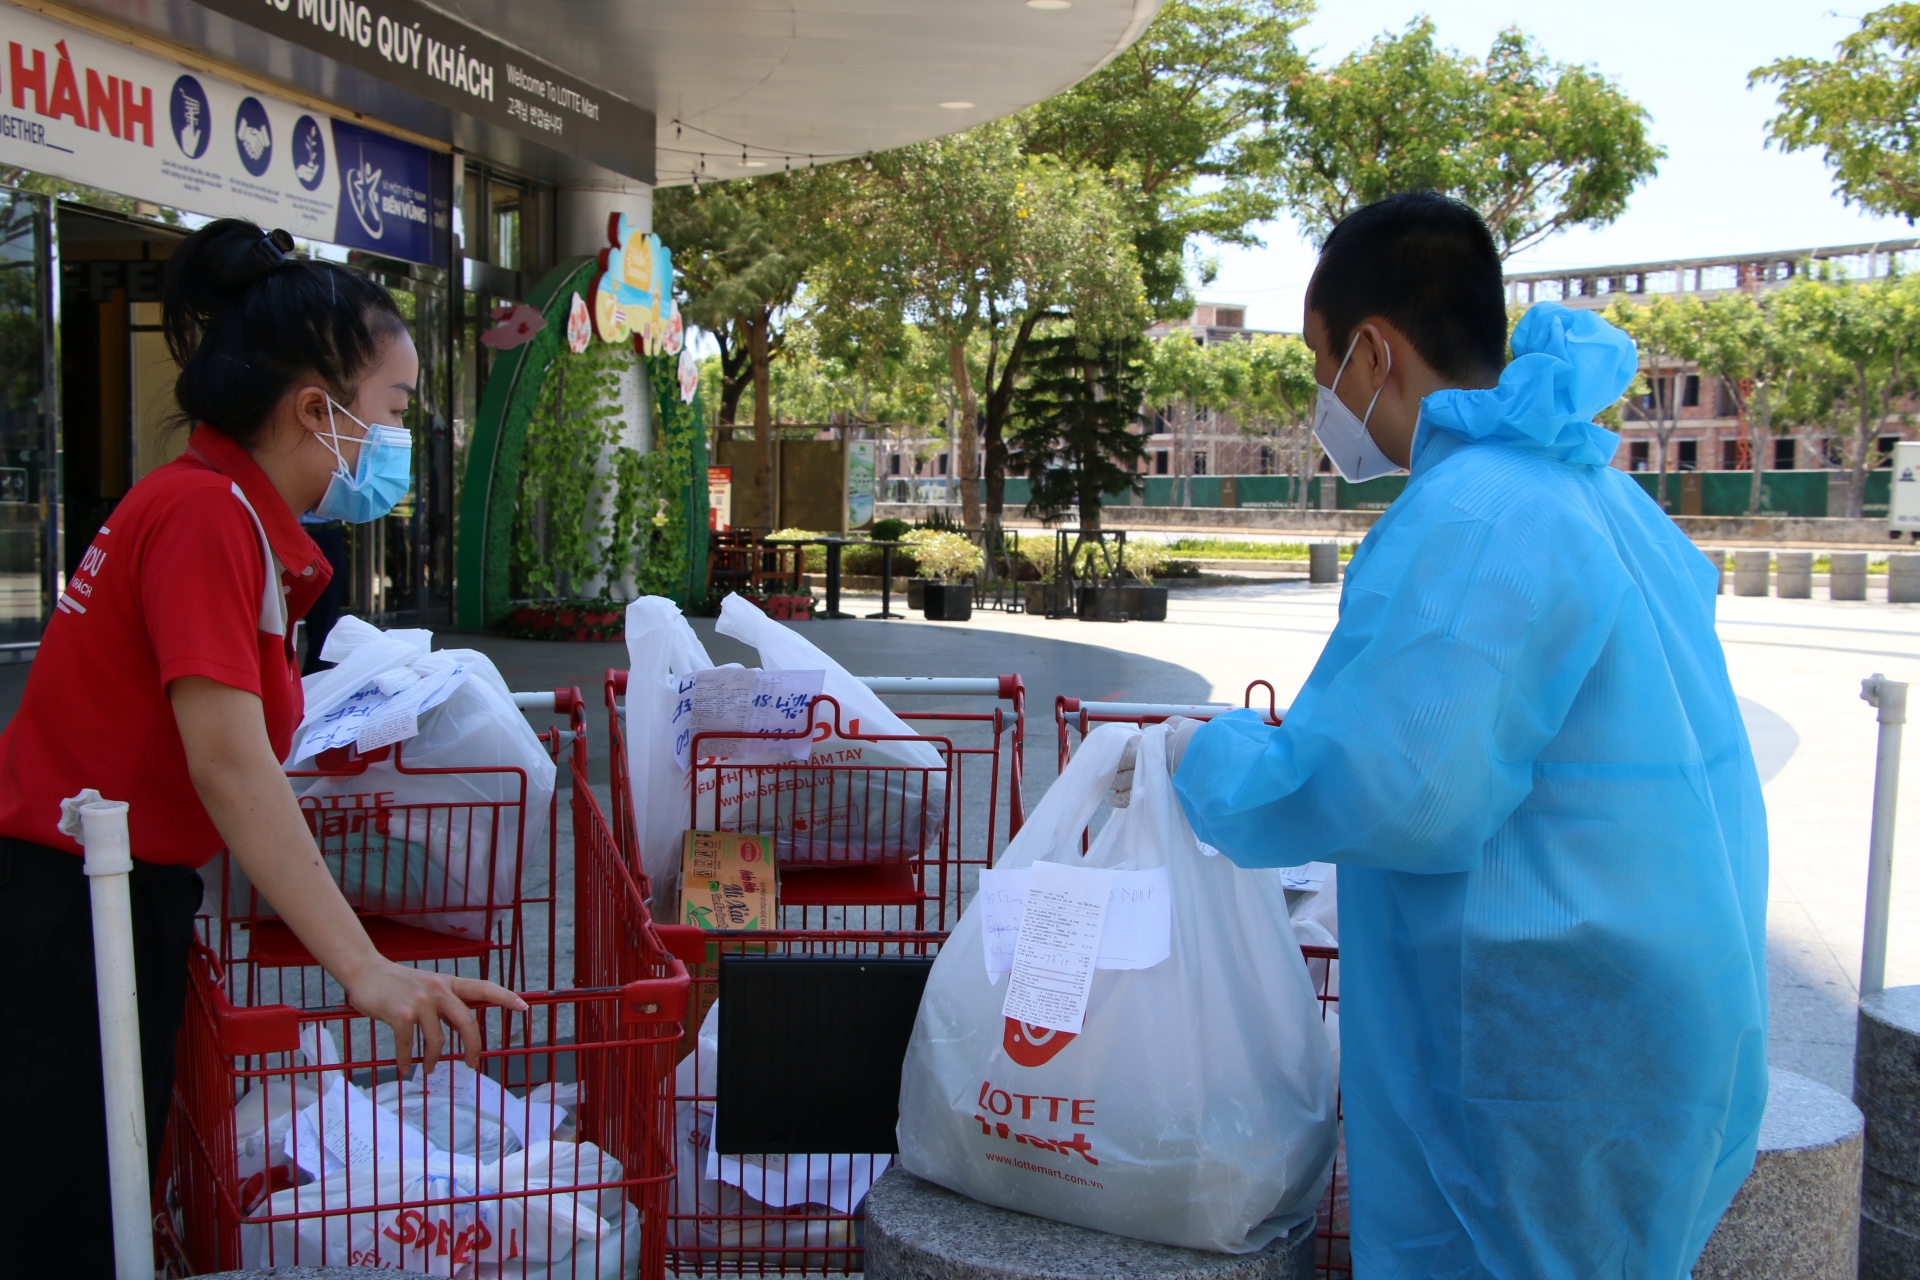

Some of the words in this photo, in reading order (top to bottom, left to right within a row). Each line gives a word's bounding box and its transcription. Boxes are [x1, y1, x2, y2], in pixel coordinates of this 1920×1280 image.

[377, 16, 423, 69] QUÝ
[427, 38, 494, 102] KHÁCH
[9, 38, 154, 148] HÀNH
[506, 62, 546, 97] Welcome
[546, 80, 558, 102] To
[557, 85, 581, 112] LOTTE
[582, 96, 599, 121] Mart
[0, 113, 46, 146] GETHER
[836, 748, 863, 762] TAY
[298, 791, 395, 809] OTTE
[978, 1081, 1095, 1125] LOTTE
[985, 1152, 1104, 1190] www.lottemart.com.vn
